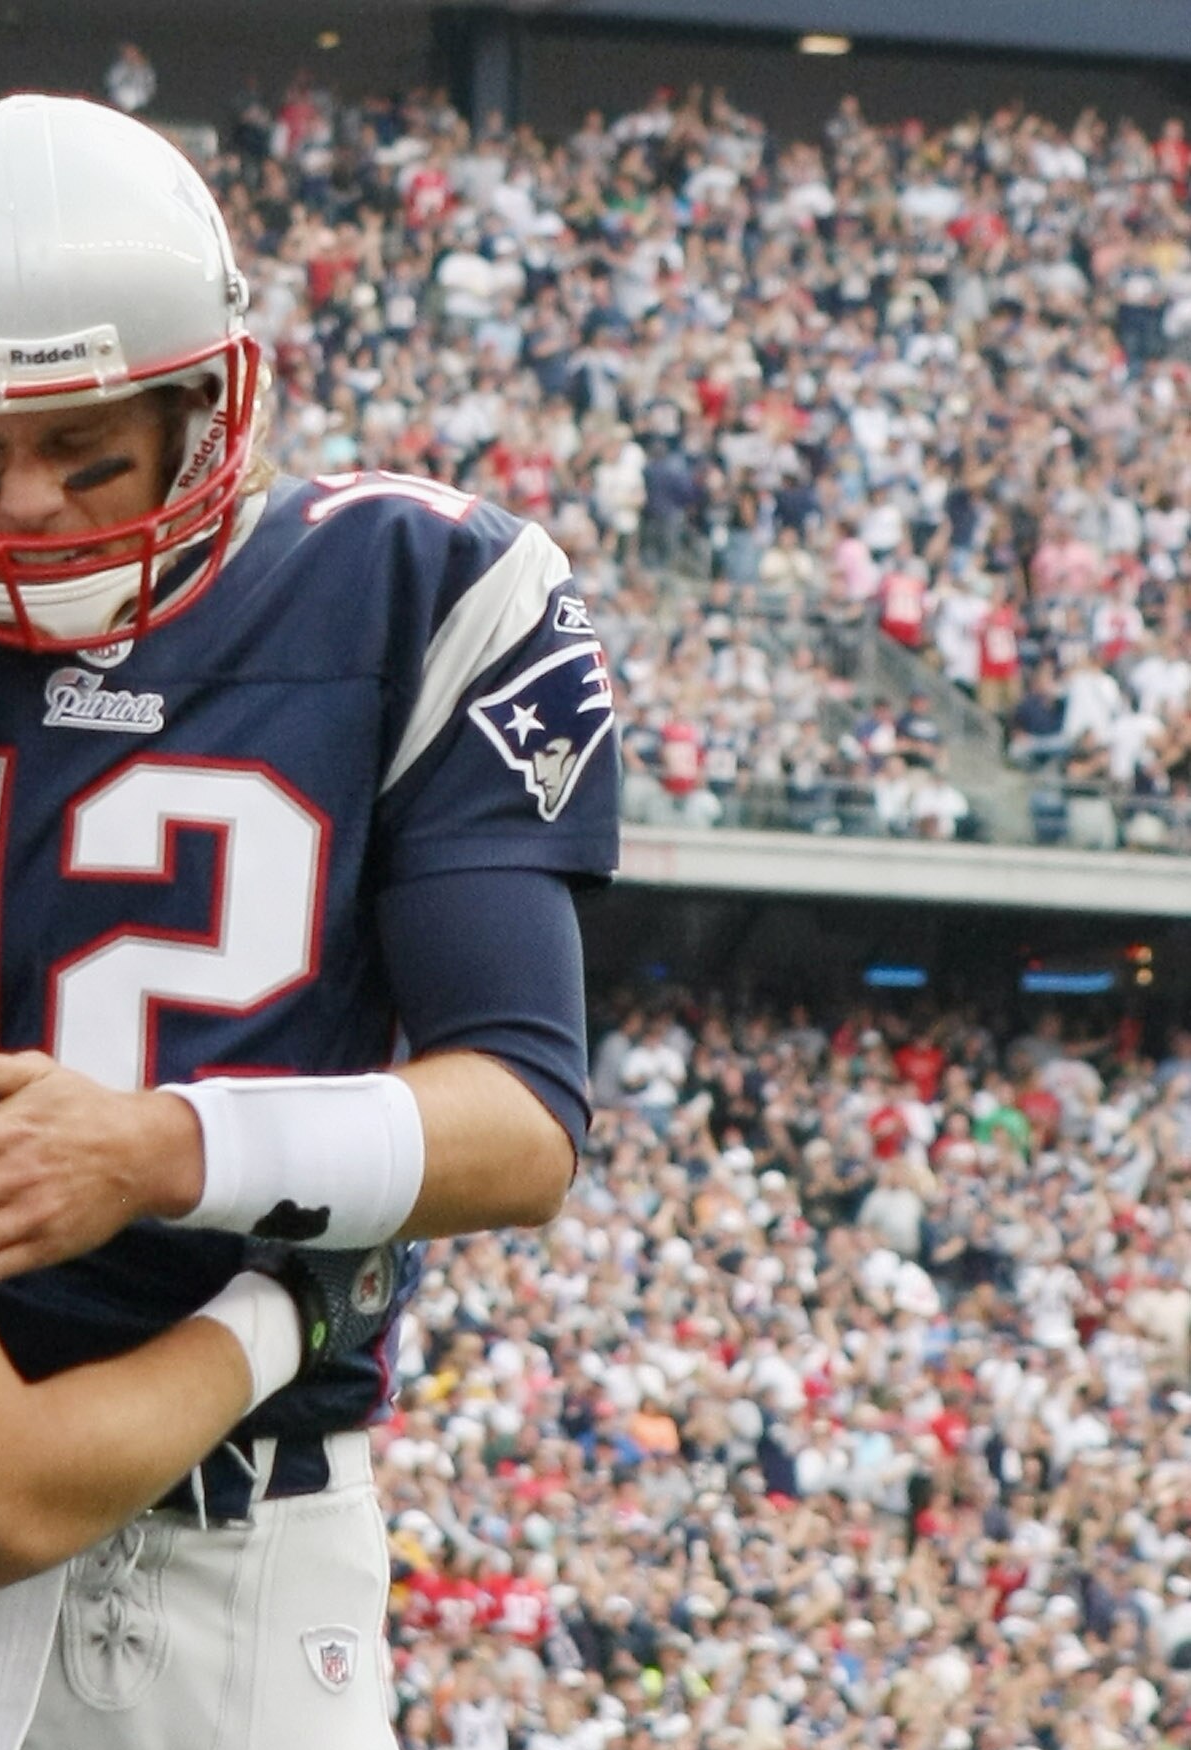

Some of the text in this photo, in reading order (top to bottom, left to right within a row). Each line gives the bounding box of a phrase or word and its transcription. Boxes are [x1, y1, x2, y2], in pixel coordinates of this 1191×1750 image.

[10, 342, 86, 364] Riddell
[178, 410, 228, 488] Riddell
[43, 685, 164, 733] Patriots
